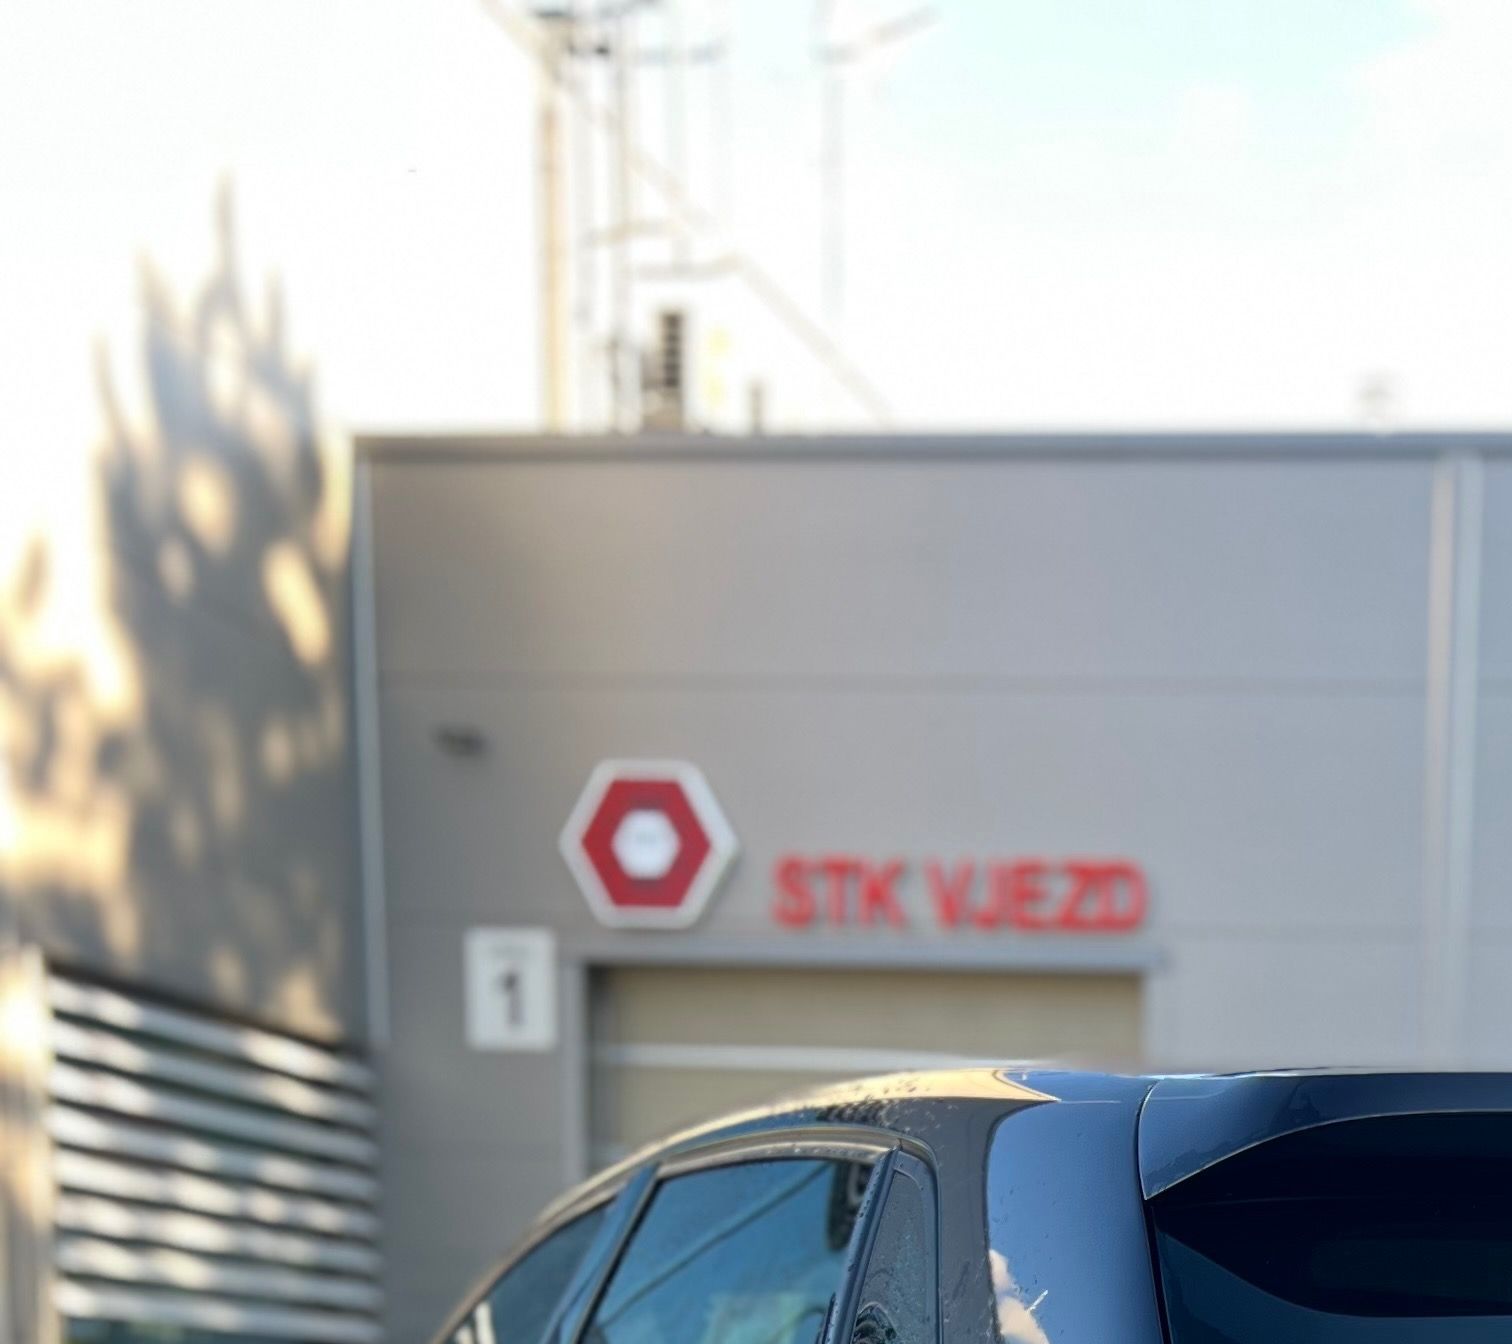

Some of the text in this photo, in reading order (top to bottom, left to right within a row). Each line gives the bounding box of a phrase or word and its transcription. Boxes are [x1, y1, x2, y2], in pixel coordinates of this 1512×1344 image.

[773, 854, 1150, 935] STK VJEZD
[494, 968, 524, 1028] 1
